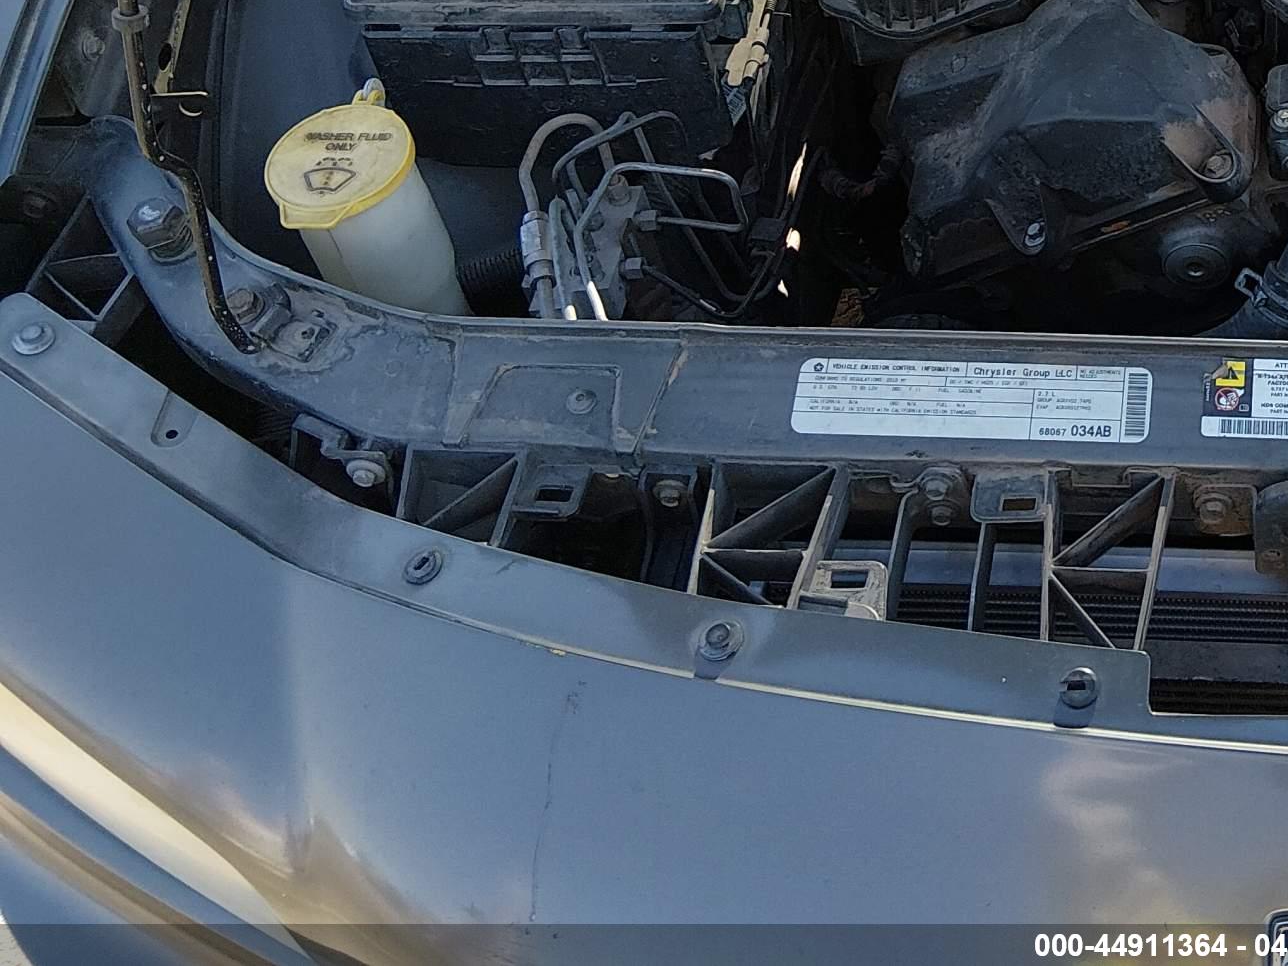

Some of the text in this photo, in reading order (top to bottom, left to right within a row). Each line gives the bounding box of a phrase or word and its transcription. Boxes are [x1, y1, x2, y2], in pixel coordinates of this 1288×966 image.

[305, 132, 393, 142] WASHER FLUID
[325, 142, 357, 151] ONLY
[892, 364, 917, 372] CONTROL
[920, 365, 960, 373] INFORMATION
[973, 366, 1073, 379] Chrysler Group LLC
[1038, 424, 1113, 438] 68067 034AB
